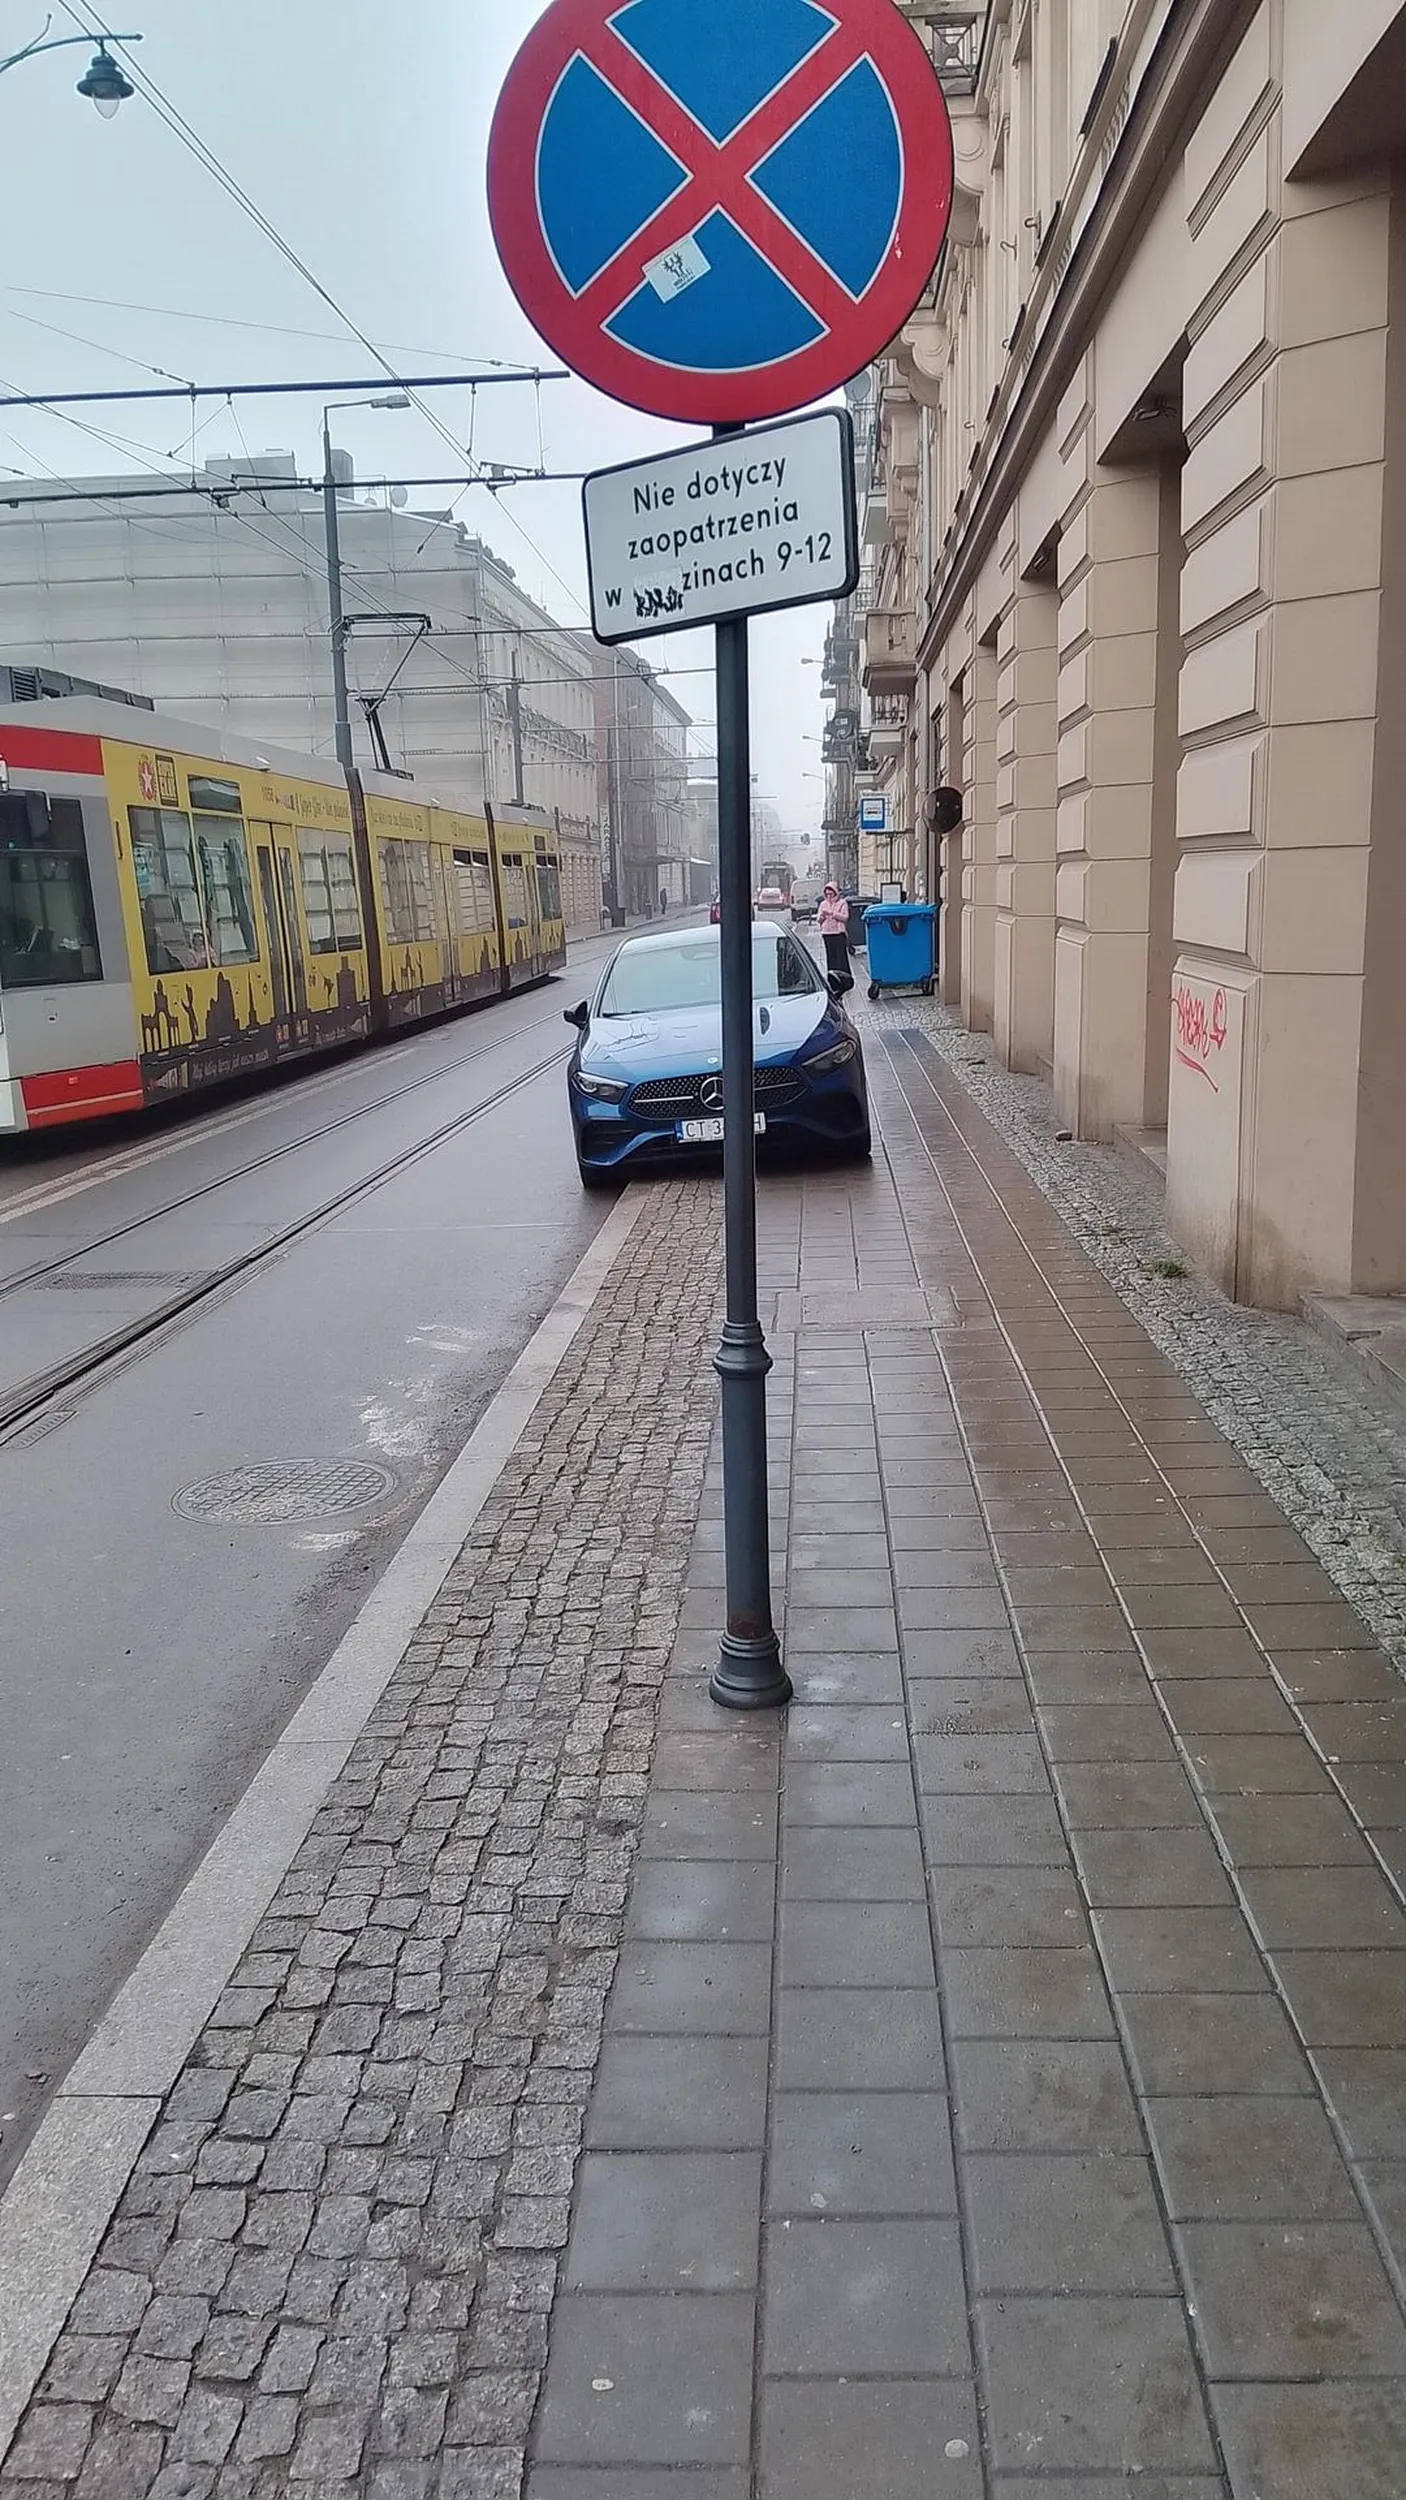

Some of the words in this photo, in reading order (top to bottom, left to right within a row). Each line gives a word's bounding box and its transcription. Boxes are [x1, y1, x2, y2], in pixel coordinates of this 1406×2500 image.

[633, 482, 675, 514] Nie
[687, 457, 786, 499] dotyczy
[628, 497, 799, 558] zaopatrzenia
[604, 587, 622, 607] w
[777, 532, 832, 571] 9-12
